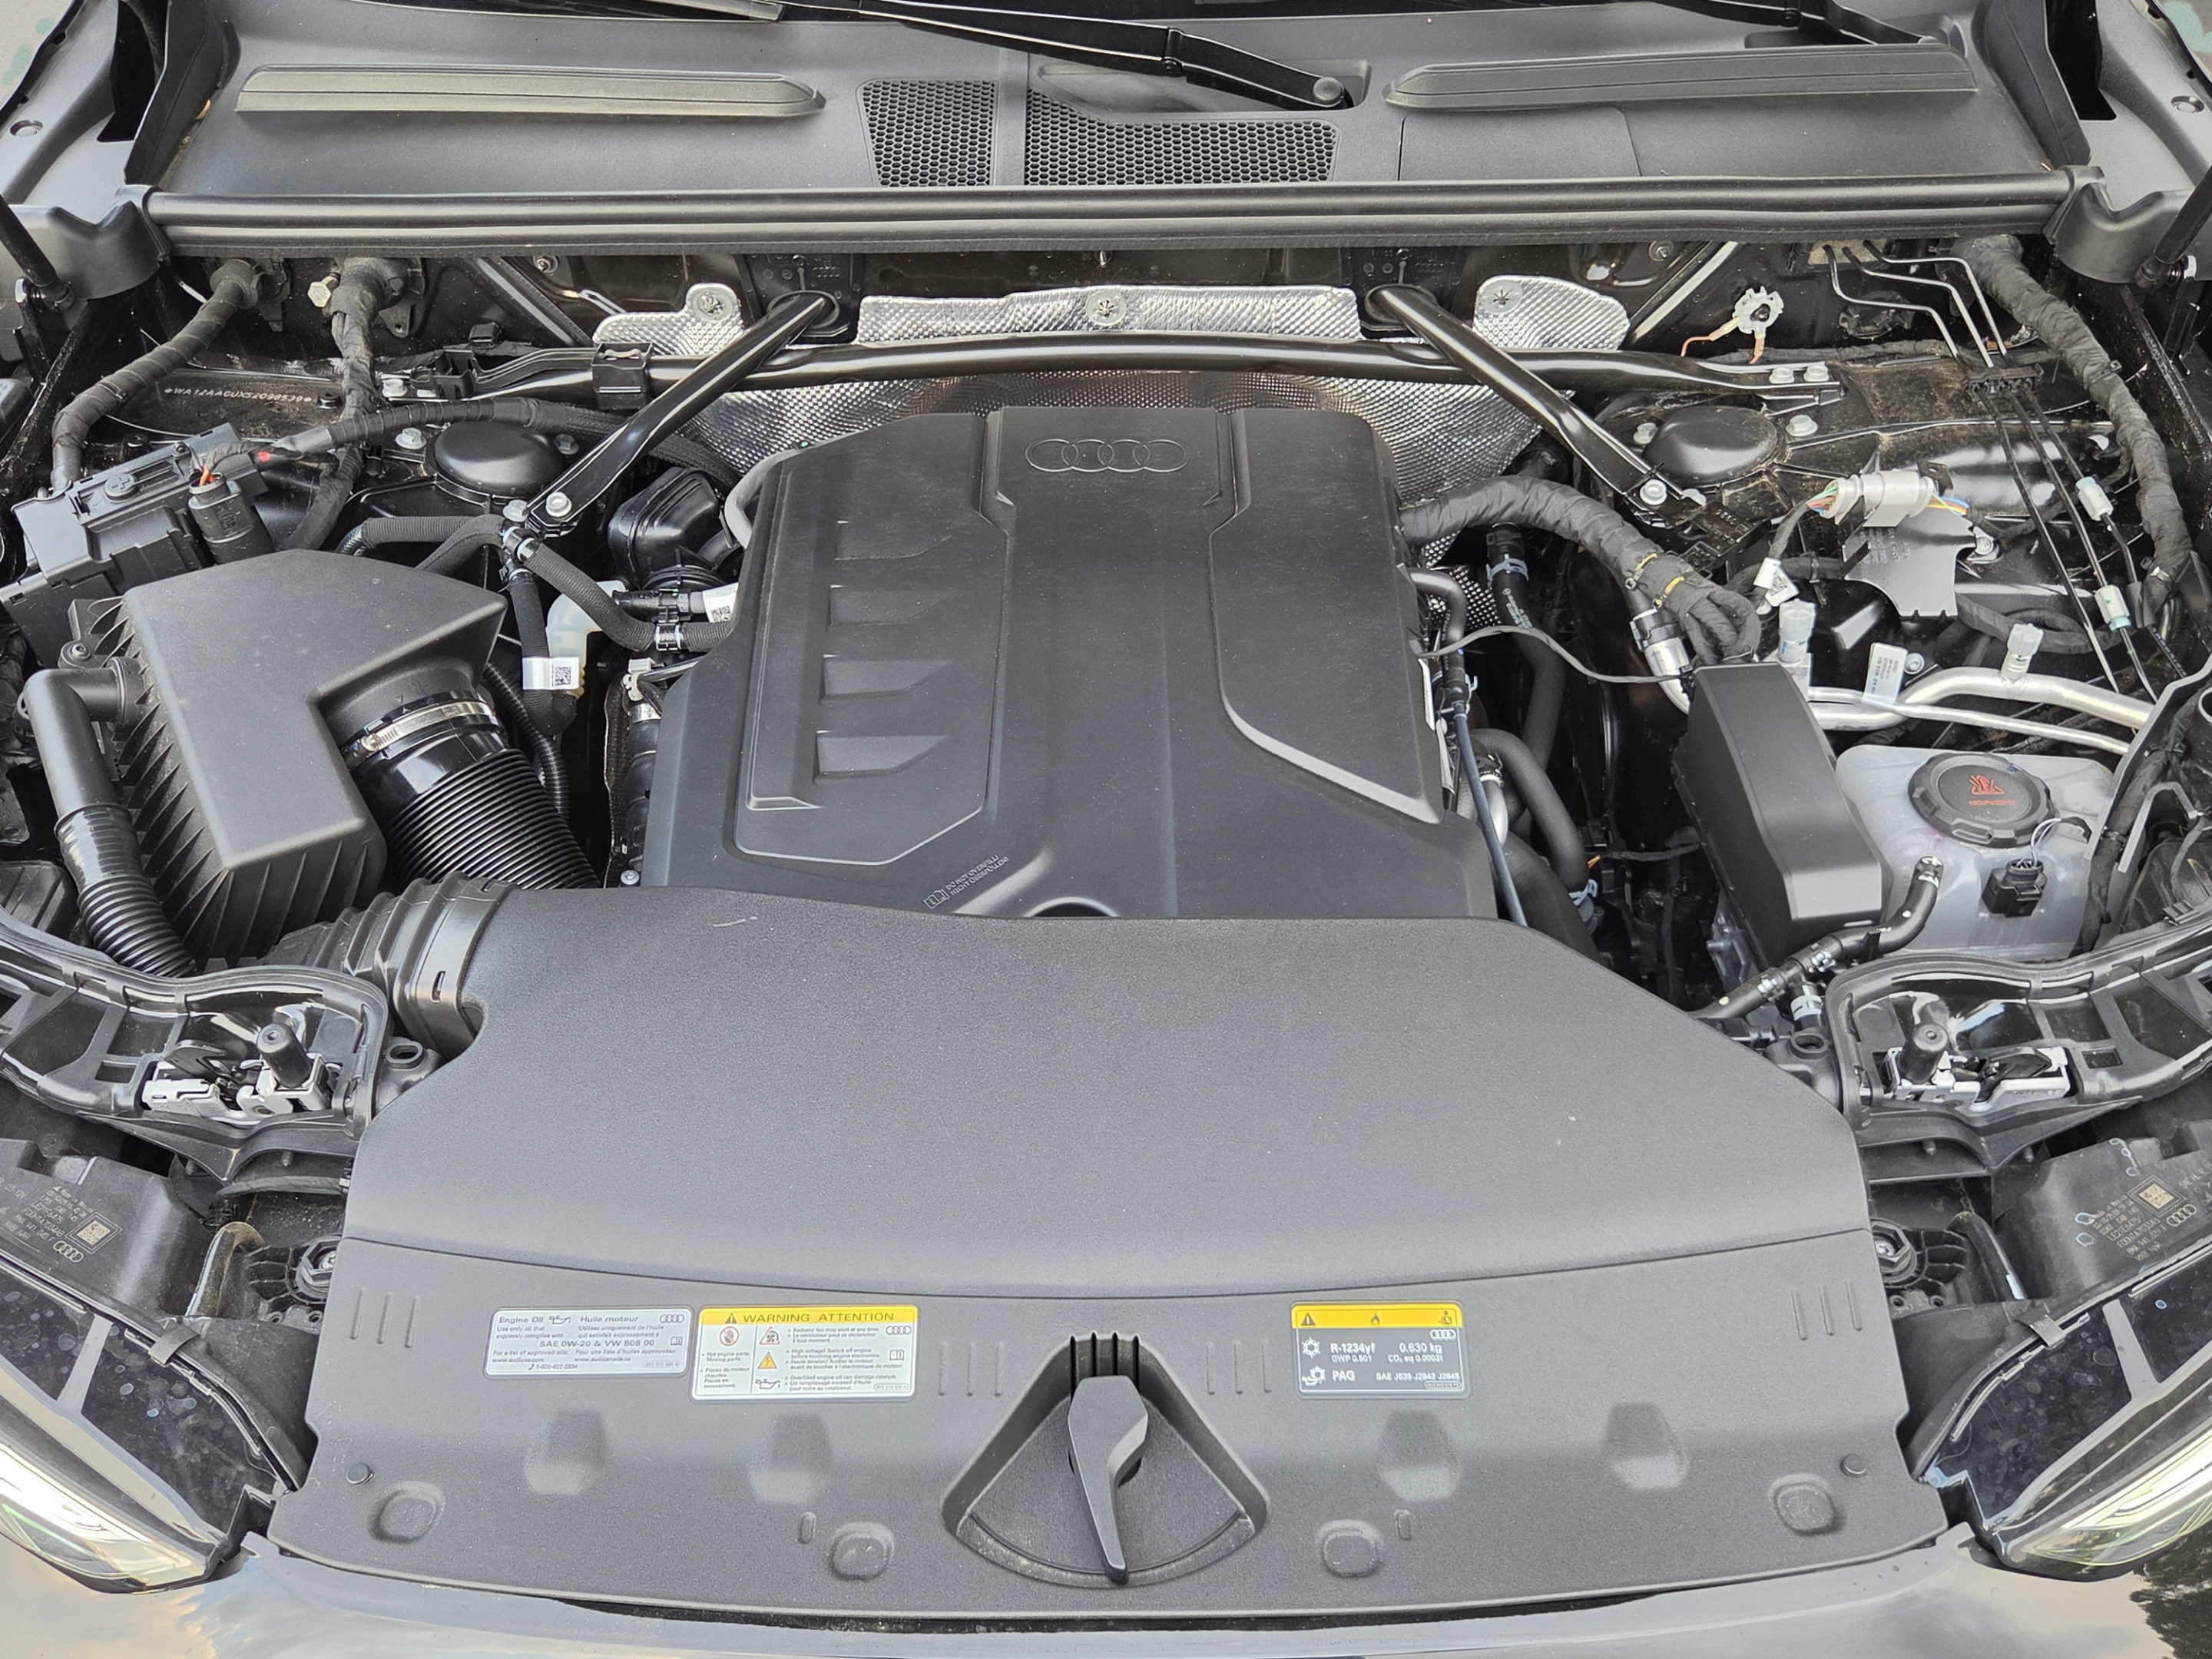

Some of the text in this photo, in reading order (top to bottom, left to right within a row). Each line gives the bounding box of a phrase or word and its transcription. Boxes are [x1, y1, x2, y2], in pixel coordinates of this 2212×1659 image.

[743, 1313, 894, 1323] WARNING ATTENTION
[1330, 1343, 1376, 1354] R-1234yf
[1399, 1343, 1442, 1354] 0.630 kg
[1405, 1356, 1414, 1364] eq
[1333, 1370, 1356, 1381] PAG
[1376, 1373, 1392, 1381] SAE
[1413, 1373, 1436, 1381] J2842
